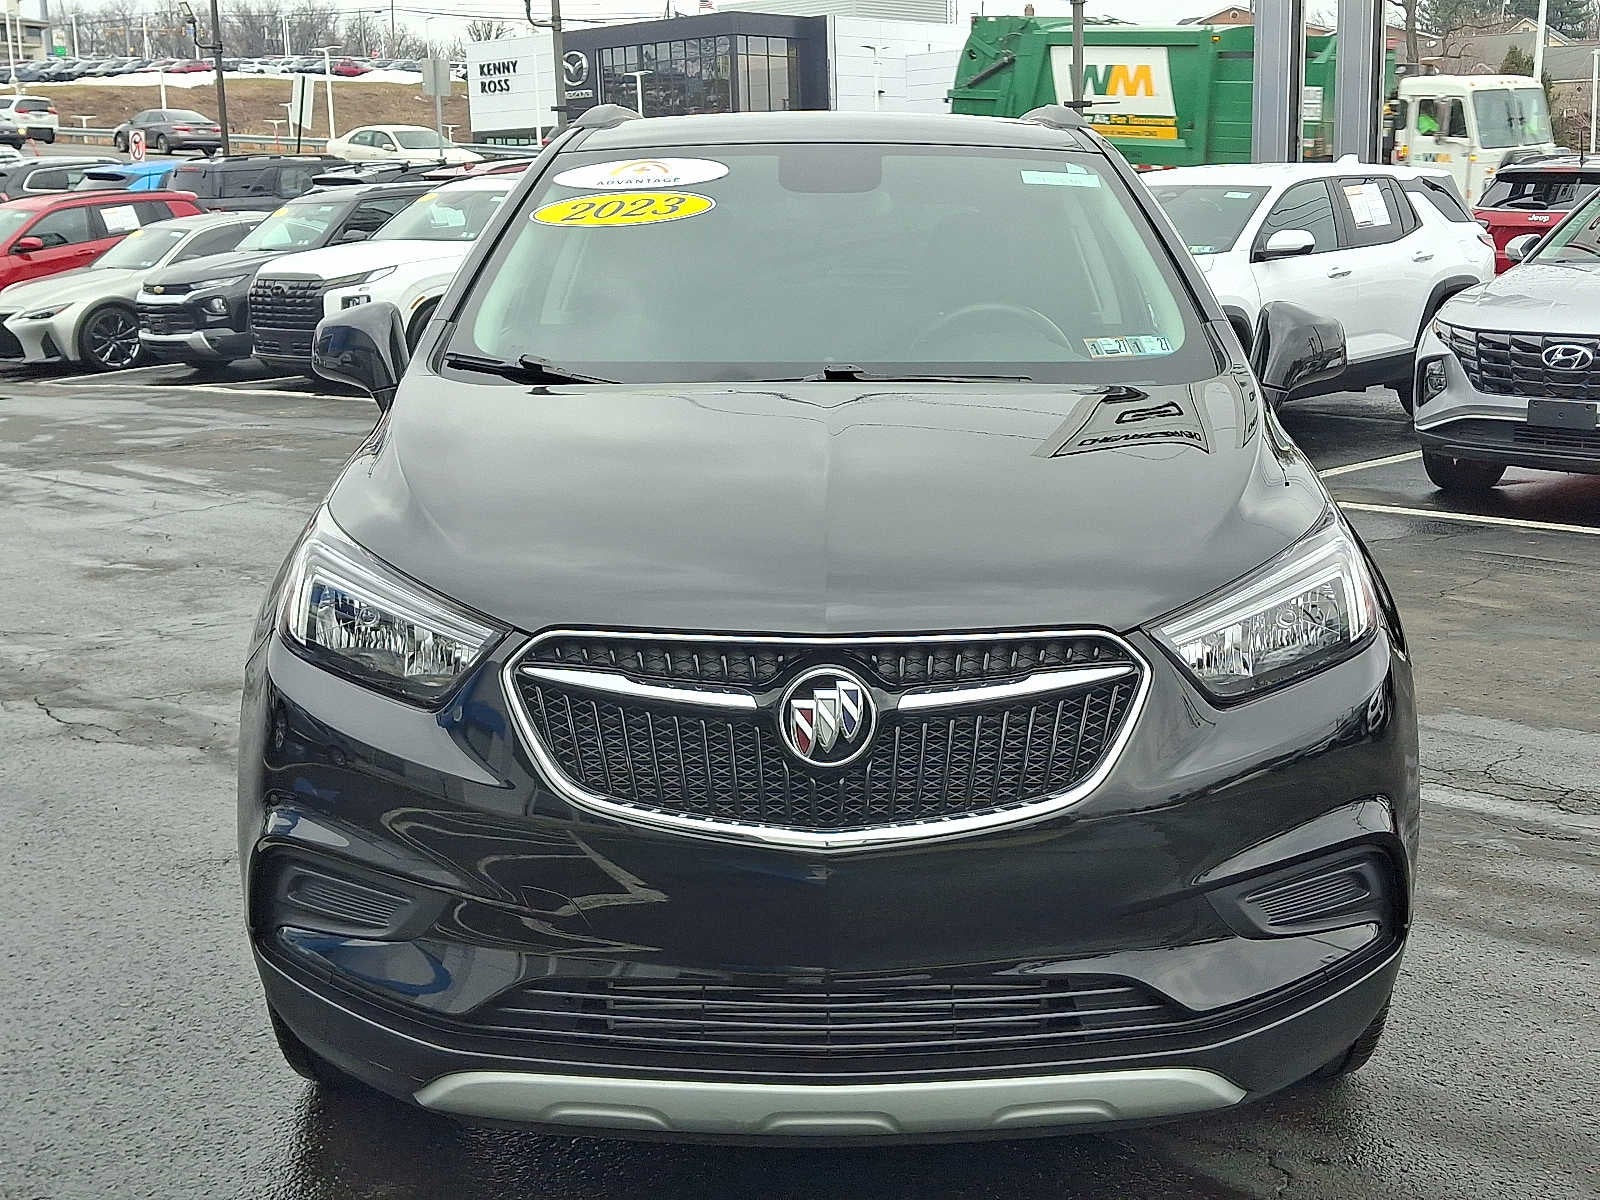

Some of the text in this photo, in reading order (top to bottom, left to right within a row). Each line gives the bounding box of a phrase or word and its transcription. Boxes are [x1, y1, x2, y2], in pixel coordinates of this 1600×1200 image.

[478, 60, 518, 77] KENNY
[480, 79, 510, 93] ROSS
[1069, 64, 1155, 96] WM
[596, 177, 681, 185] ADVANTAGE
[561, 197, 685, 222] 2023
[1528, 214, 1550, 223] Jeep
